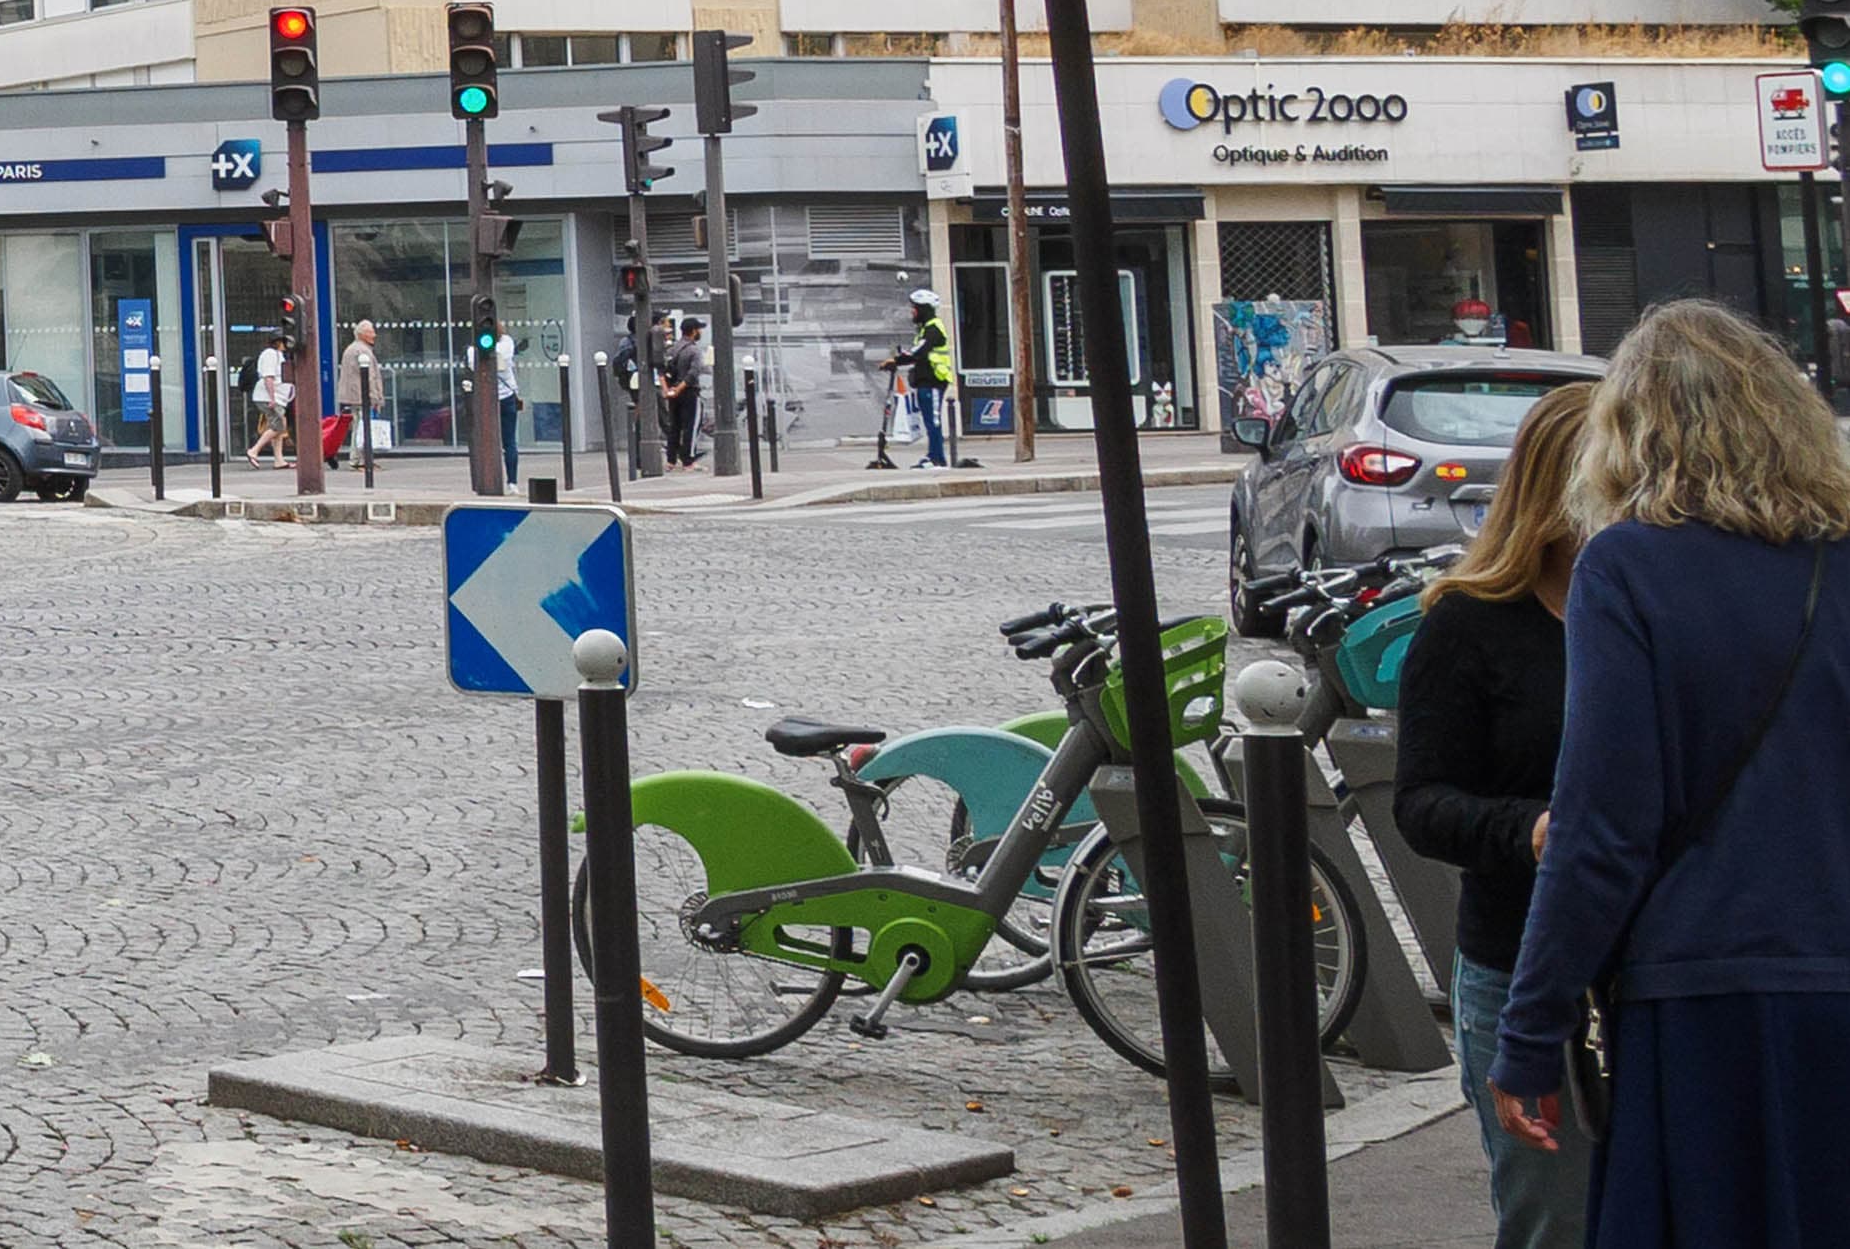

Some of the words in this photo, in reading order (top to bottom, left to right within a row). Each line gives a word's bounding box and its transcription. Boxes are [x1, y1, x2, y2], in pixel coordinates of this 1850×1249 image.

[1185, 83, 1300, 134] Optic
[1213, 144, 1289, 166] Optique
[1292, 144, 1307, 162] &
[1312, 144, 1389, 163] Audition
